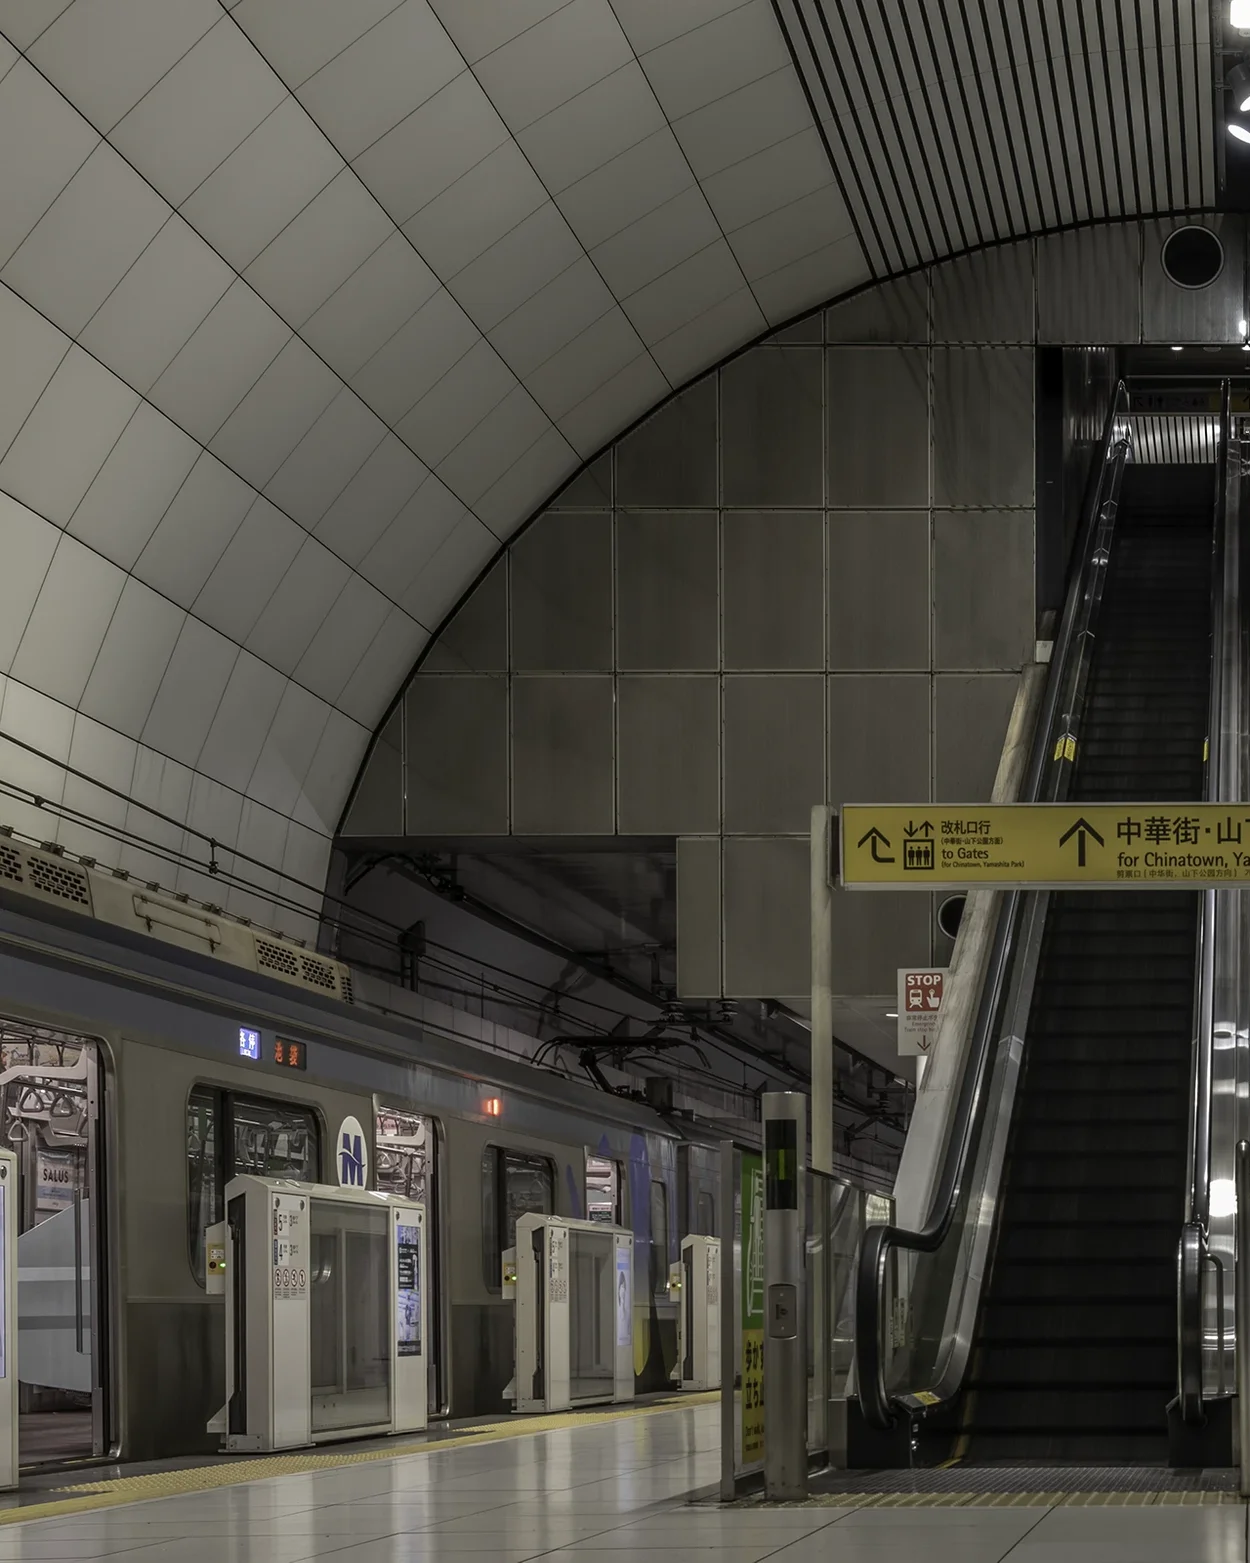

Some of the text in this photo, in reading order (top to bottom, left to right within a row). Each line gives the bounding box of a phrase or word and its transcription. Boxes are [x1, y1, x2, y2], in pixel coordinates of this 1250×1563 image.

[941, 820, 991, 835] 改札口行
[941, 847, 989, 859] to Gates
[1117, 852, 1139, 867] for
[1144, 852, 1228, 868] Chinatown,
[907, 975, 942, 986] STOP
[43, 1168, 69, 1183] SALUS
